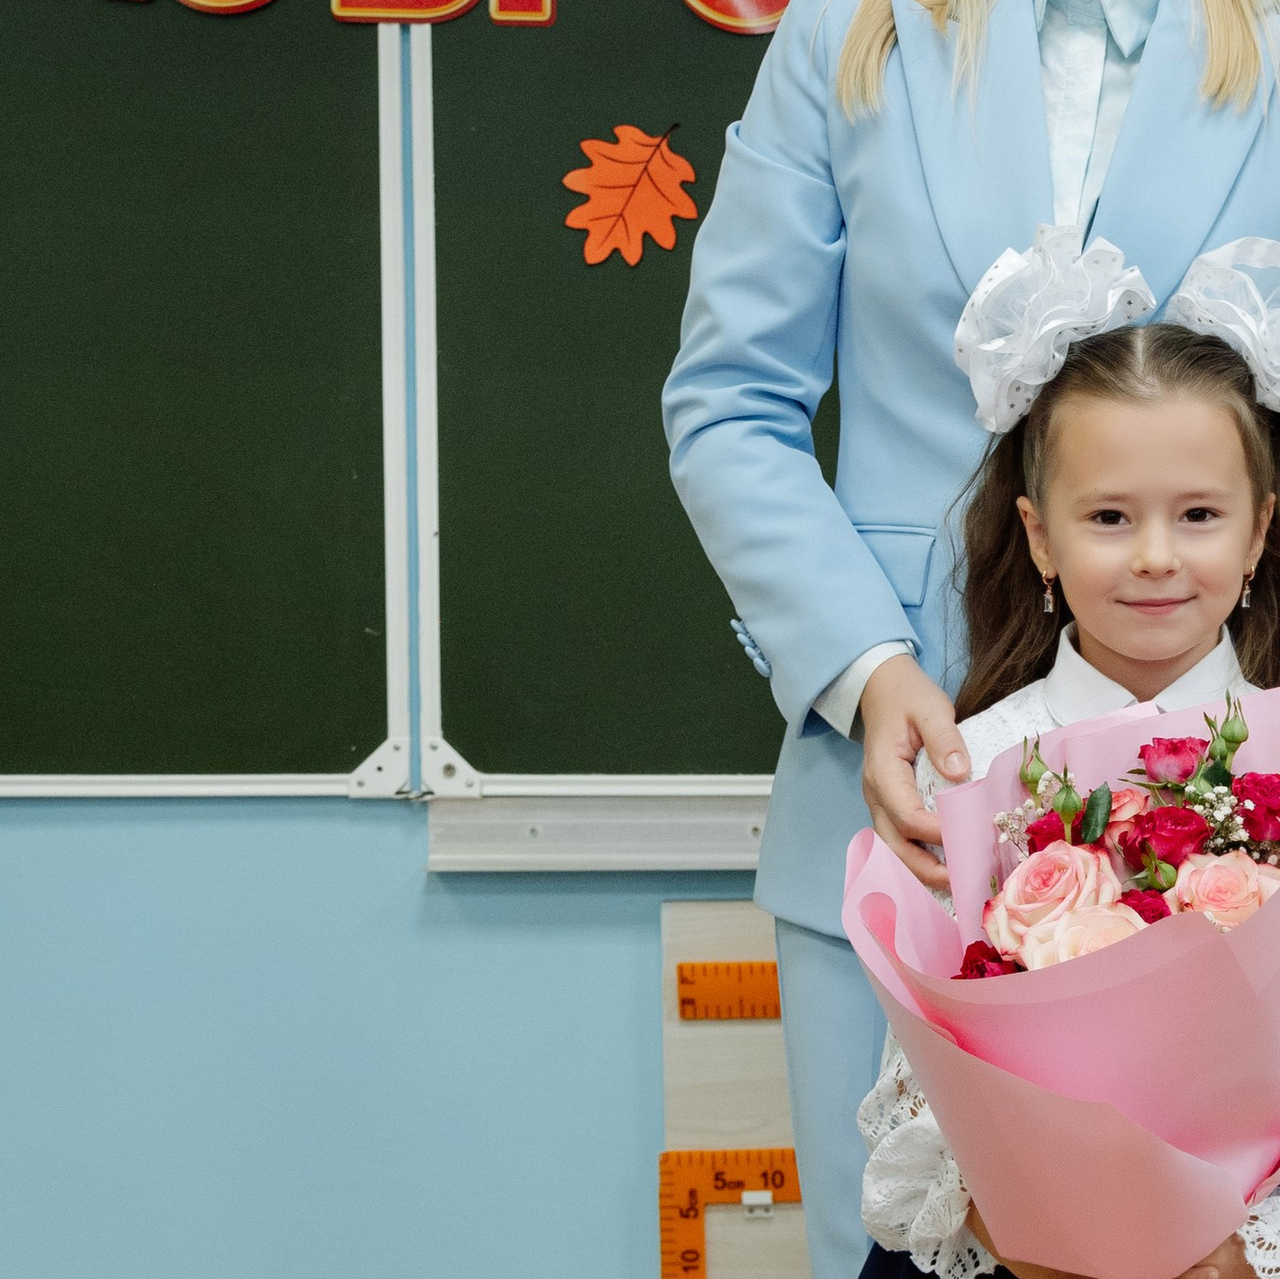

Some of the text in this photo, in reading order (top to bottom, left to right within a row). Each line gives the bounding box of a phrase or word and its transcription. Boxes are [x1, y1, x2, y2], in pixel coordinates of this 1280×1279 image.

[713, 1169, 785, 1192] 5cm 10
[679, 1248, 700, 1274] 10
